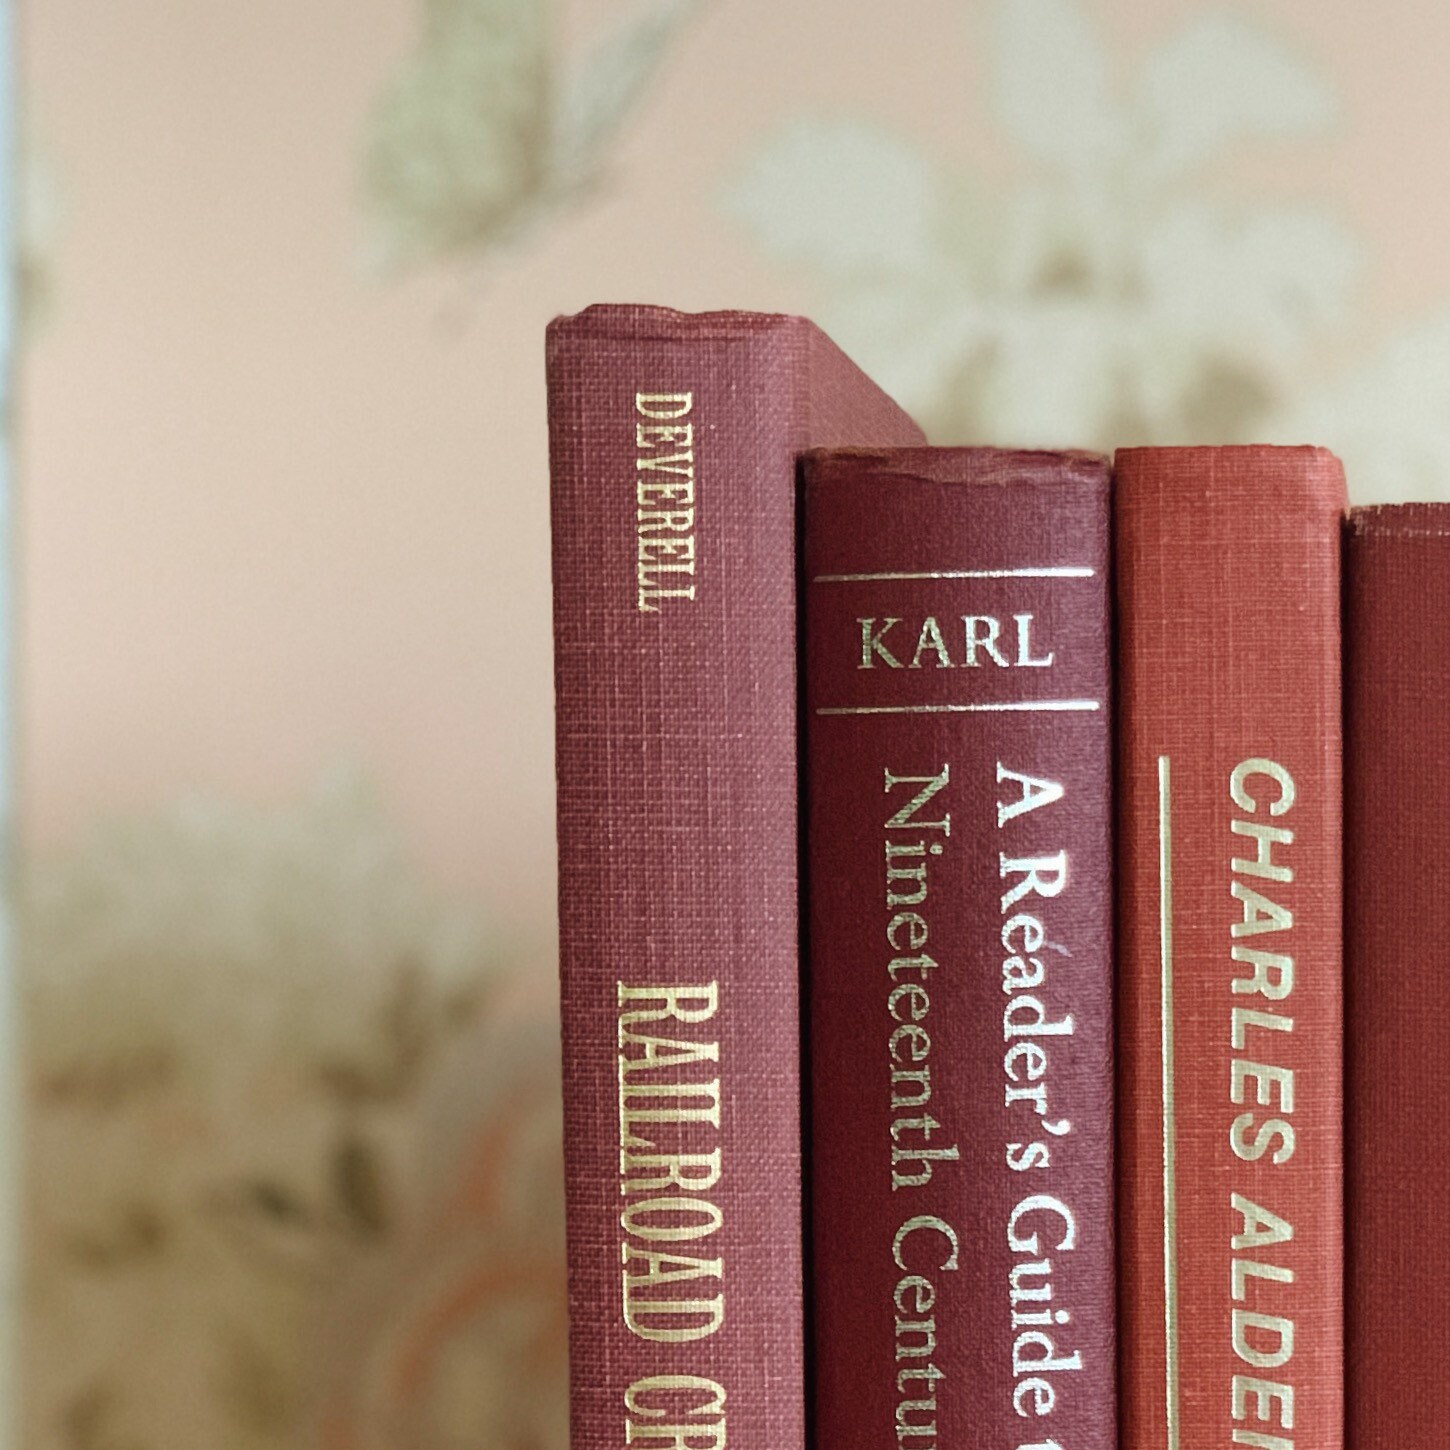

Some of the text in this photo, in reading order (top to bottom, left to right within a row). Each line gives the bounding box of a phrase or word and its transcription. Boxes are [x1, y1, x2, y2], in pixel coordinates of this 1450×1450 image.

[635, 391, 696, 613] DEVERELL
[856, 613, 1055, 670] KARL
[995, 761, 1066, 829] A
[884, 763, 961, 1192] Nineteenth
[998, 849, 1077, 1172] Reader's
[1229, 756, 1297, 1165] CHARLES
[616, 980, 725, 1343] RAILROAD
[1007, 1195, 1082, 1418] Guide
